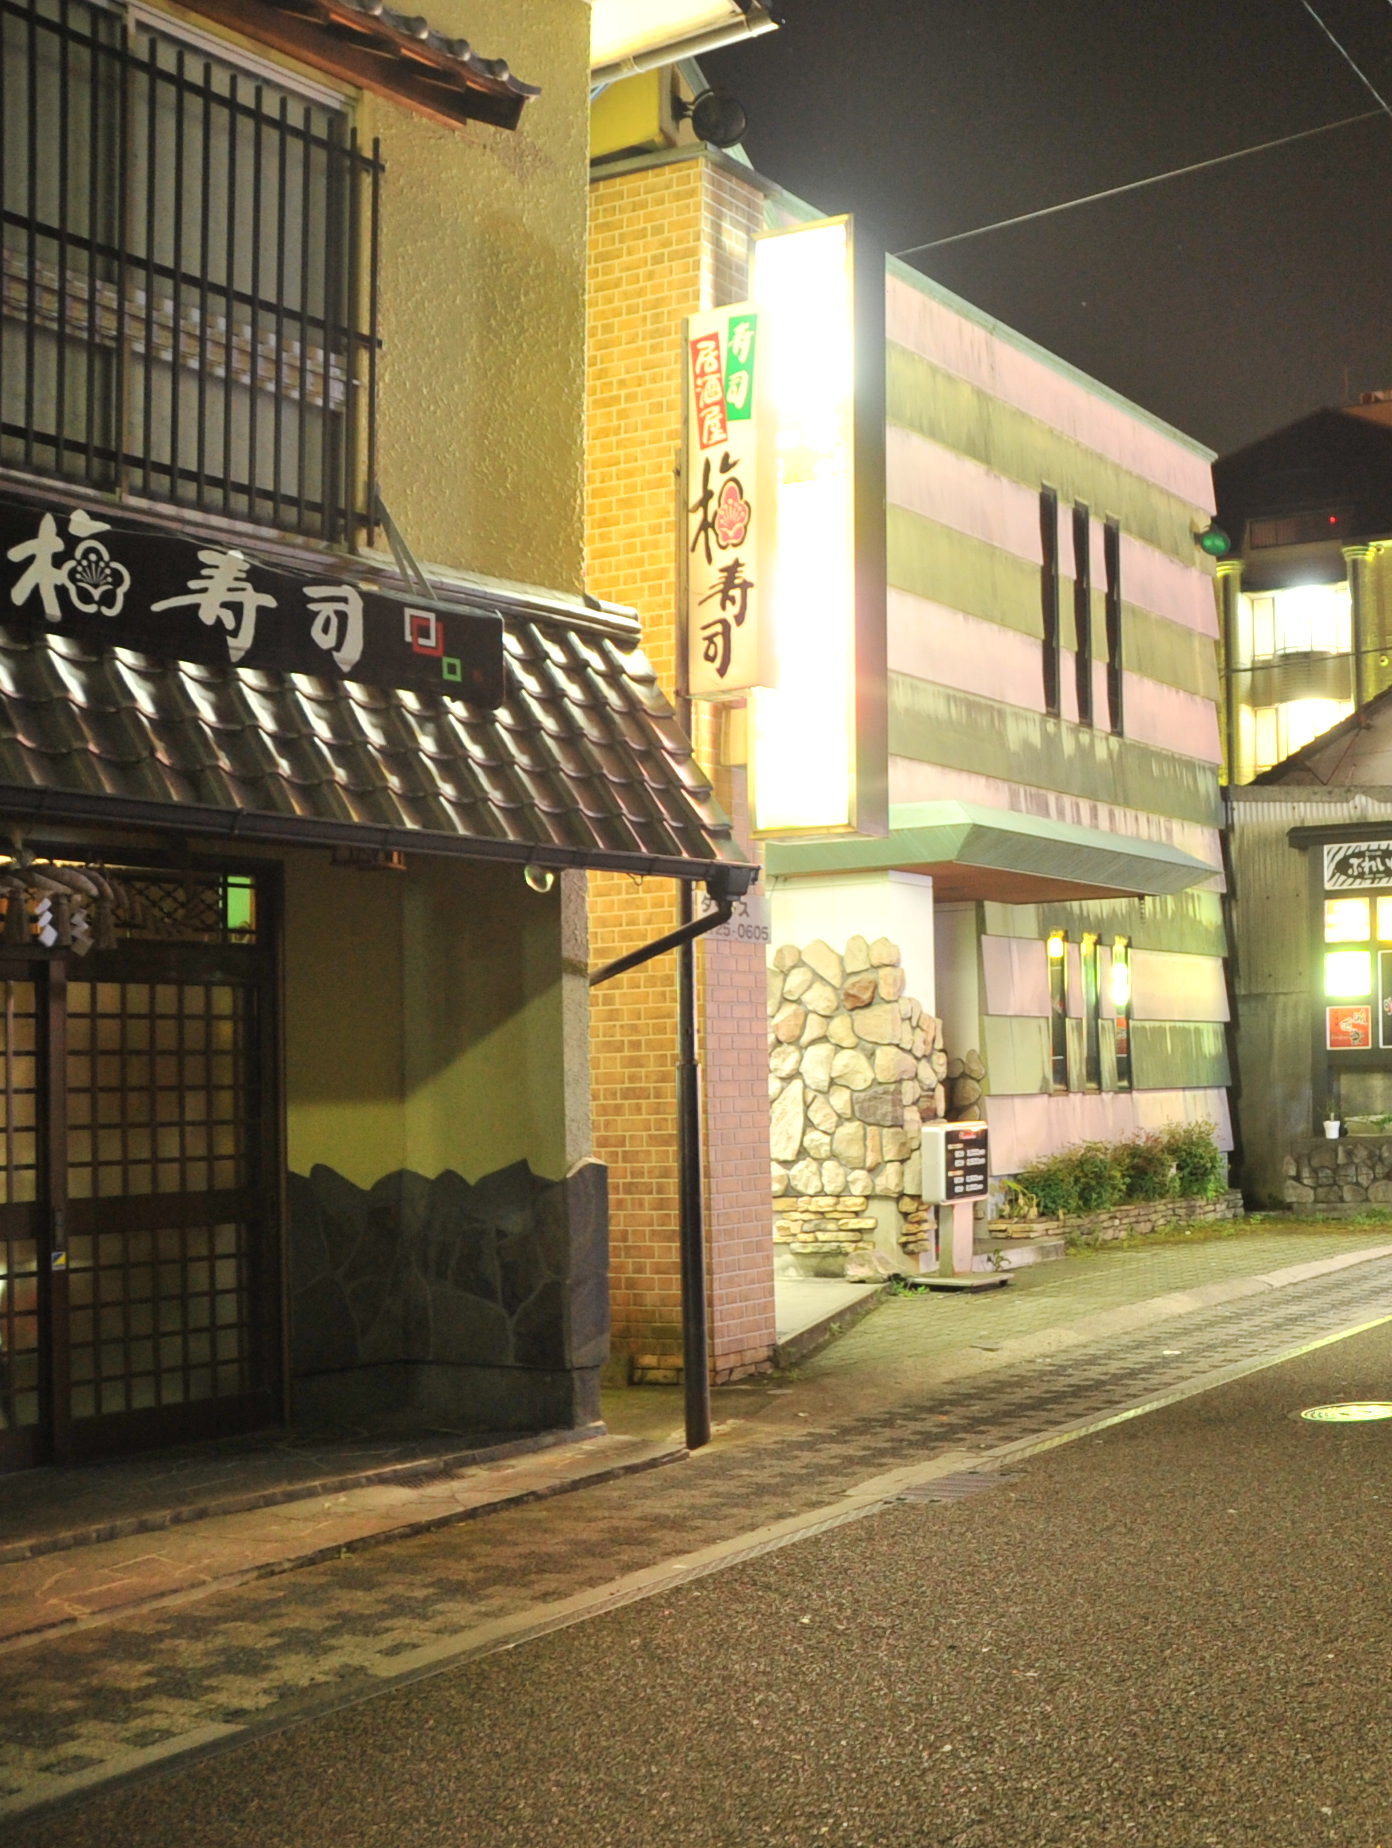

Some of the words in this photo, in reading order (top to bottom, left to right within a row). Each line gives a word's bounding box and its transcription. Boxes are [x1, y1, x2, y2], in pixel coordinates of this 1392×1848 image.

[695, 340, 728, 448] 居酒屋
[727, 322, 755, 410] 寿司
